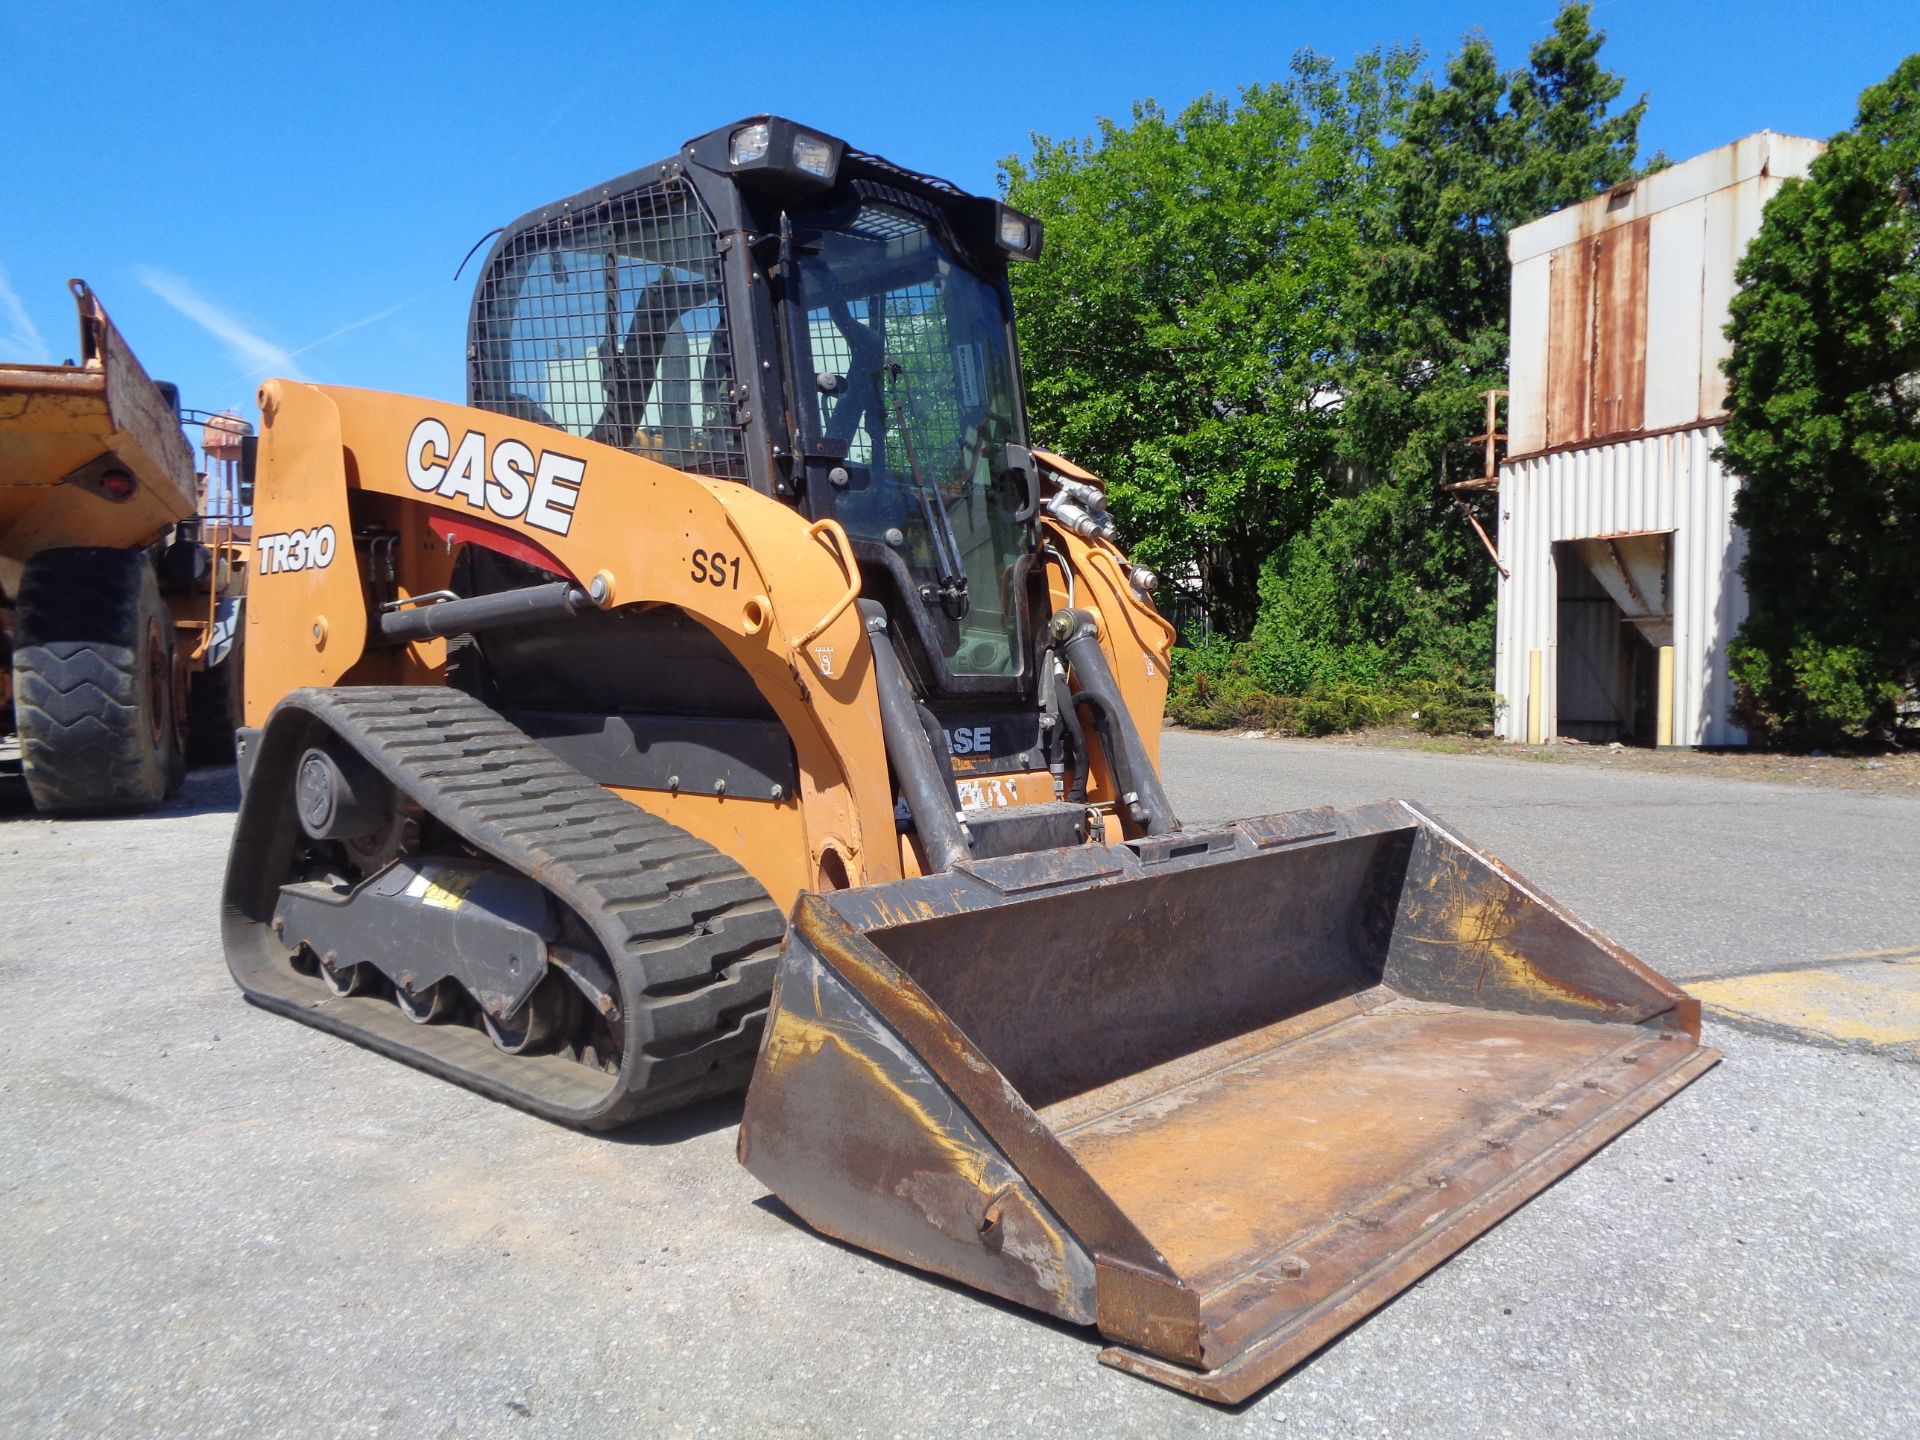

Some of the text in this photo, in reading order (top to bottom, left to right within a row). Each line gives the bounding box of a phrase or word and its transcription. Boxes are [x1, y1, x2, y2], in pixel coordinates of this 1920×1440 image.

[406, 417, 587, 537] CASE
[257, 524, 336, 576] TR310
[691, 549, 740, 590] SS1
[943, 727, 991, 754] SE
